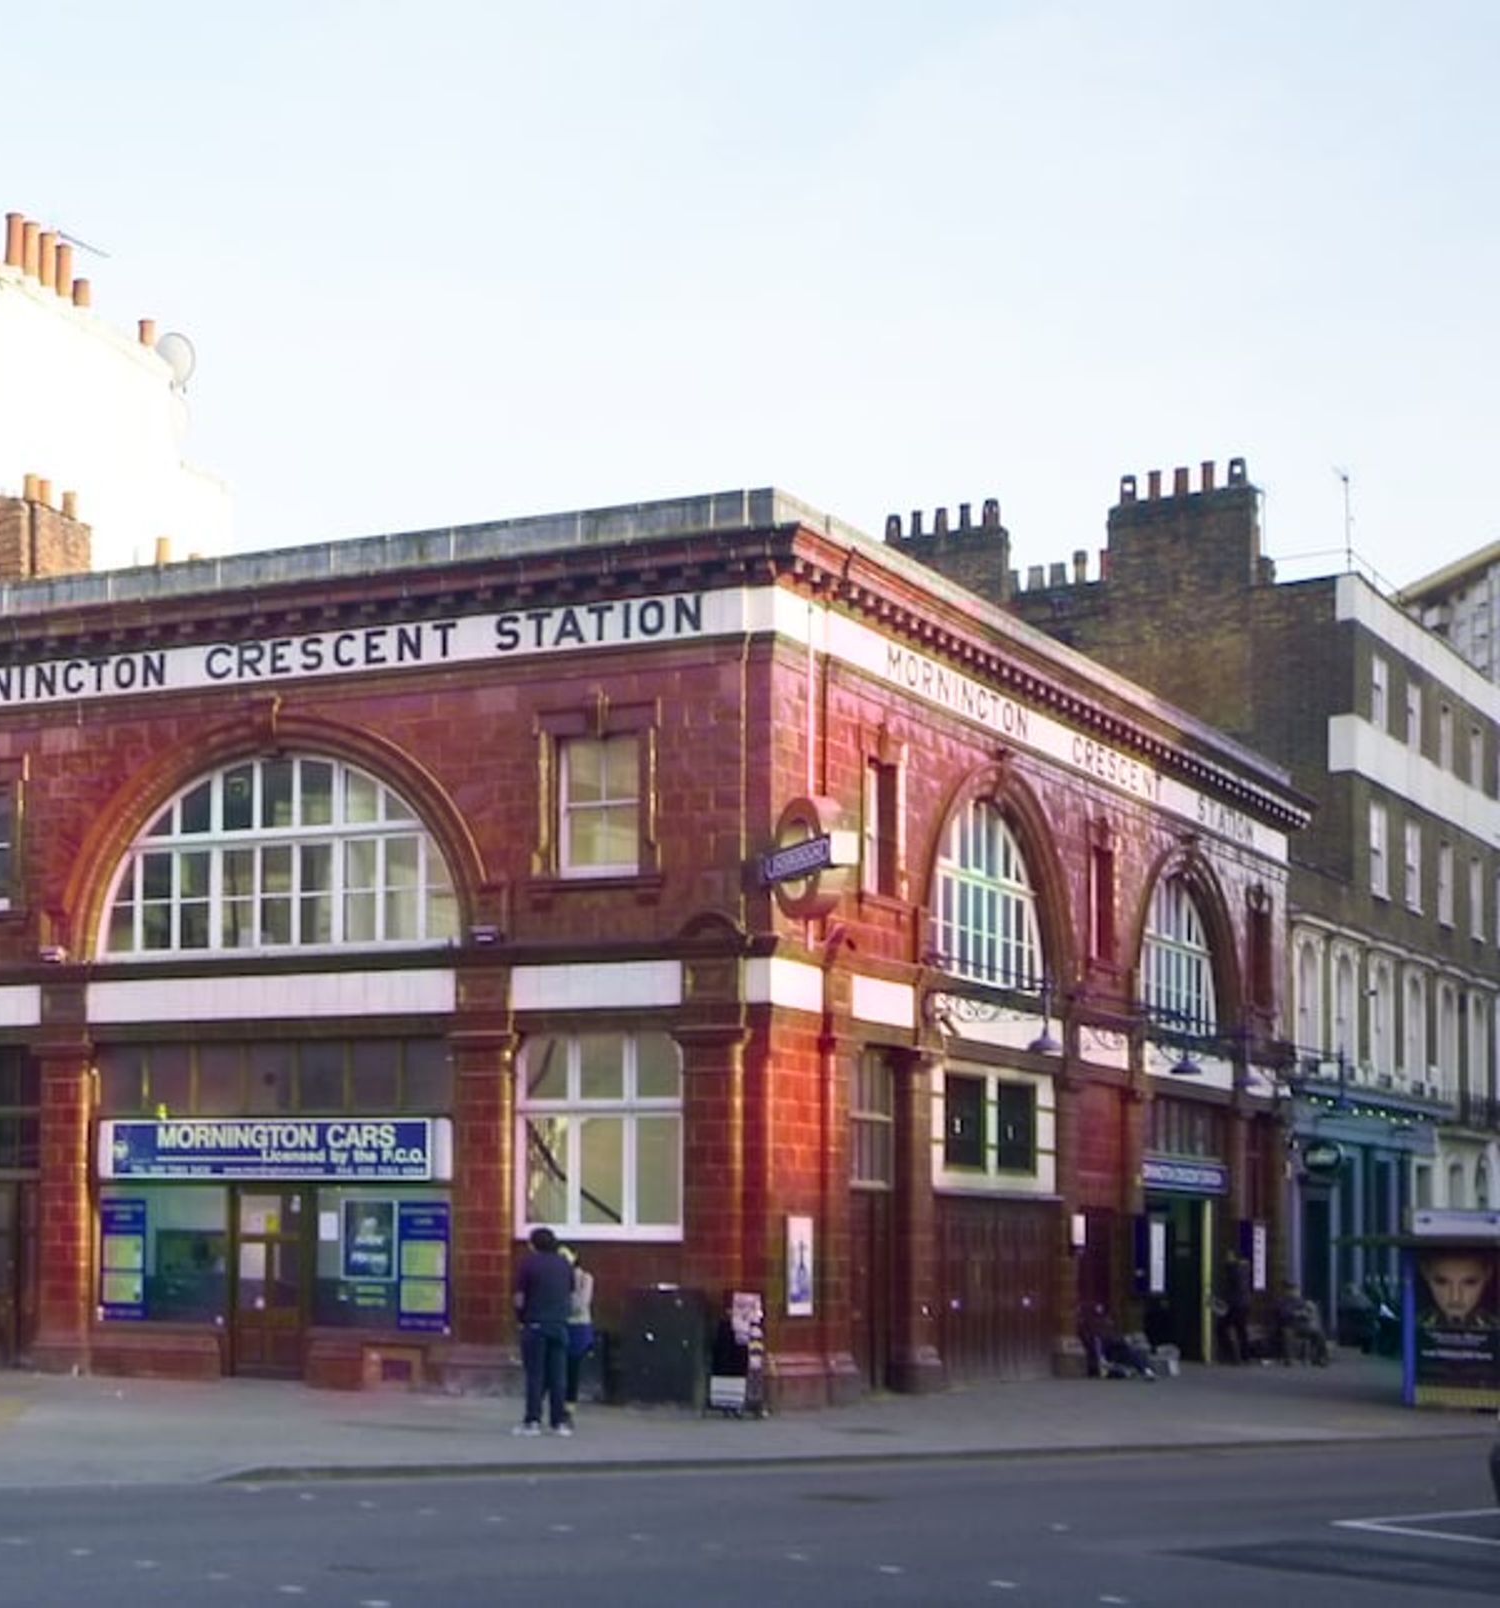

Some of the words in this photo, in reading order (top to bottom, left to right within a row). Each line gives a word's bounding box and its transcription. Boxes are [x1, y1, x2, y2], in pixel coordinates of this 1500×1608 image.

[204, 622, 457, 679] CRESCENT
[495, 595, 703, 651] STATION
[887, 644, 1028, 737] MORNINGTON
[1073, 735, 1162, 801] CRESCENT
[157, 1124, 317, 1149] MORNINGTON
[326, 1124, 397, 1149] CARS
[262, 1149, 326, 1163] Licensed
[330, 1149, 349, 1165] by
[353, 1149, 378, 1163] the
[382, 1148, 426, 1163] P.C.O.
